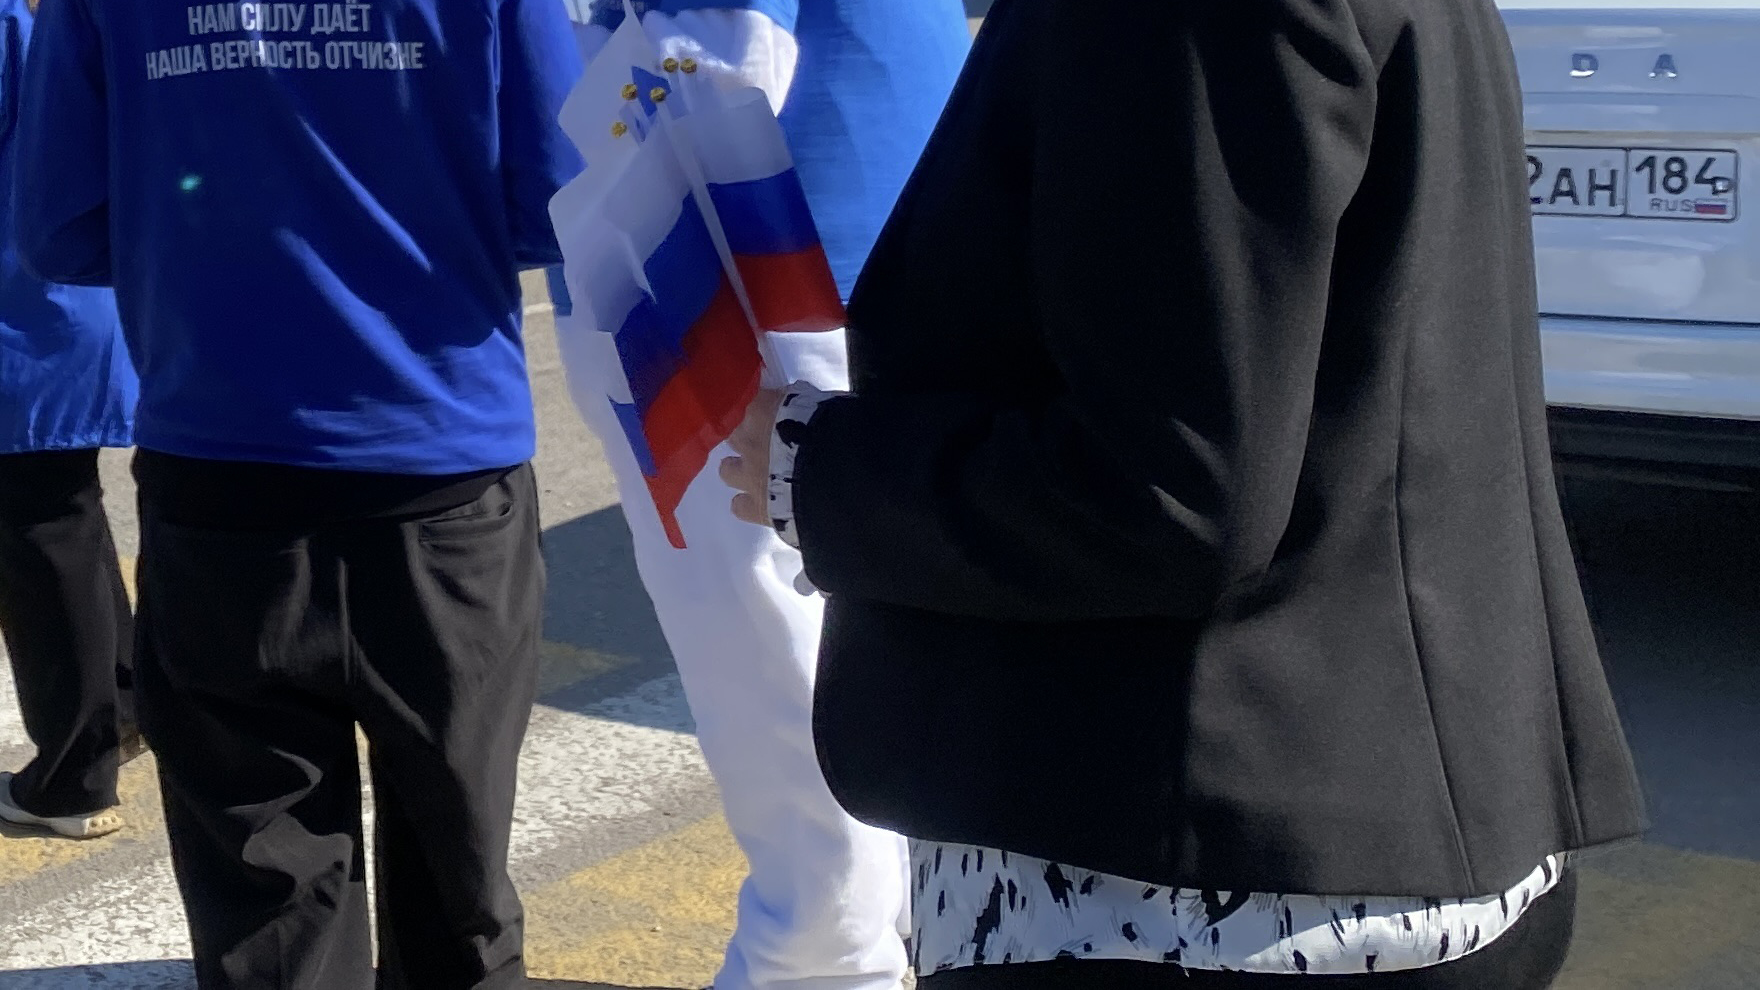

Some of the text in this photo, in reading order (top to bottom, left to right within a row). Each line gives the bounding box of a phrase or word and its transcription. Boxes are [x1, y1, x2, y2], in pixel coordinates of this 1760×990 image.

[188, 0, 371, 35] НАМ СИЛУ ДАЁТ
[145, 40, 425, 81] НАША ВЕРНОСТЬ ОТЧИЗНЕ
